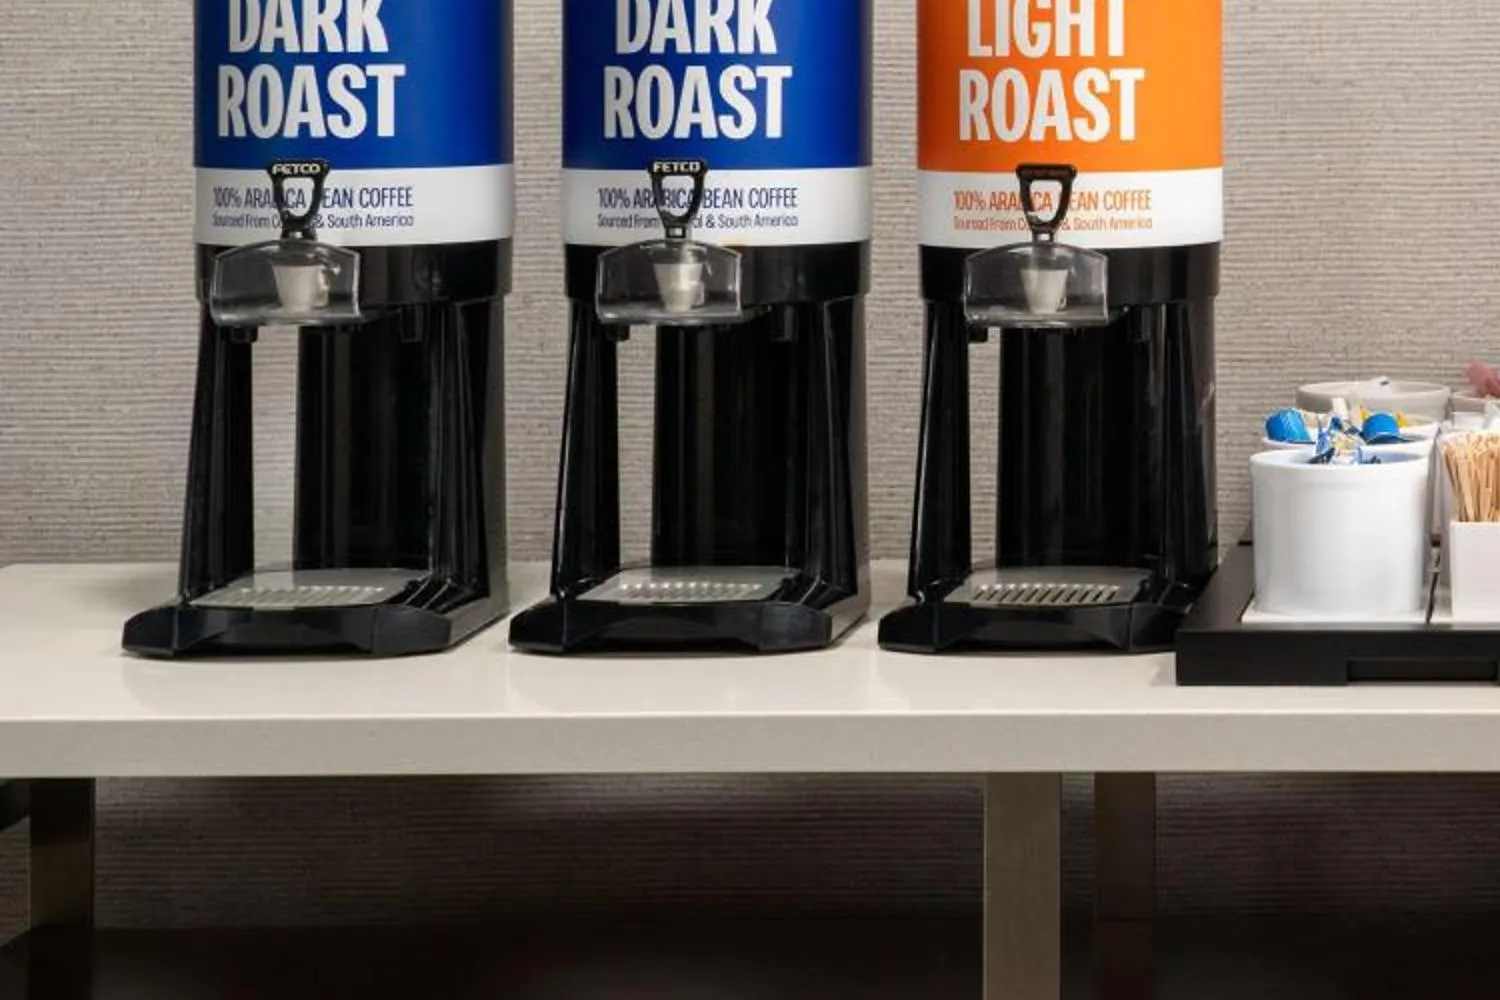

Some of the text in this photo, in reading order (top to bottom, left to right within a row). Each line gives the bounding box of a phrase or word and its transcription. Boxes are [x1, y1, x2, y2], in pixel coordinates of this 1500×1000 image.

[218, 64, 406, 138] ROAST
[603, 64, 793, 139] ROAST
[959, 67, 1145, 143] ROAST
[272, 163, 320, 175] FETCO
[653, 161, 700, 173] FETCO
[245, 187, 306, 209] ARACA
[319, 187, 353, 208] EAN
[359, 186, 414, 208] COFFEE
[598, 187, 631, 209] 100%
[703, 186, 743, 208] BEAN
[749, 186, 798, 208] COFFEE
[953, 189, 1152, 211] 100% ARACA EAN COFFEE
[327, 213, 362, 229] South
[365, 213, 414, 228] America
[705, 213, 716, 229] &
[718, 213, 752, 229] South
[754, 212, 799, 227] America
[1073, 216, 1105, 230] South
